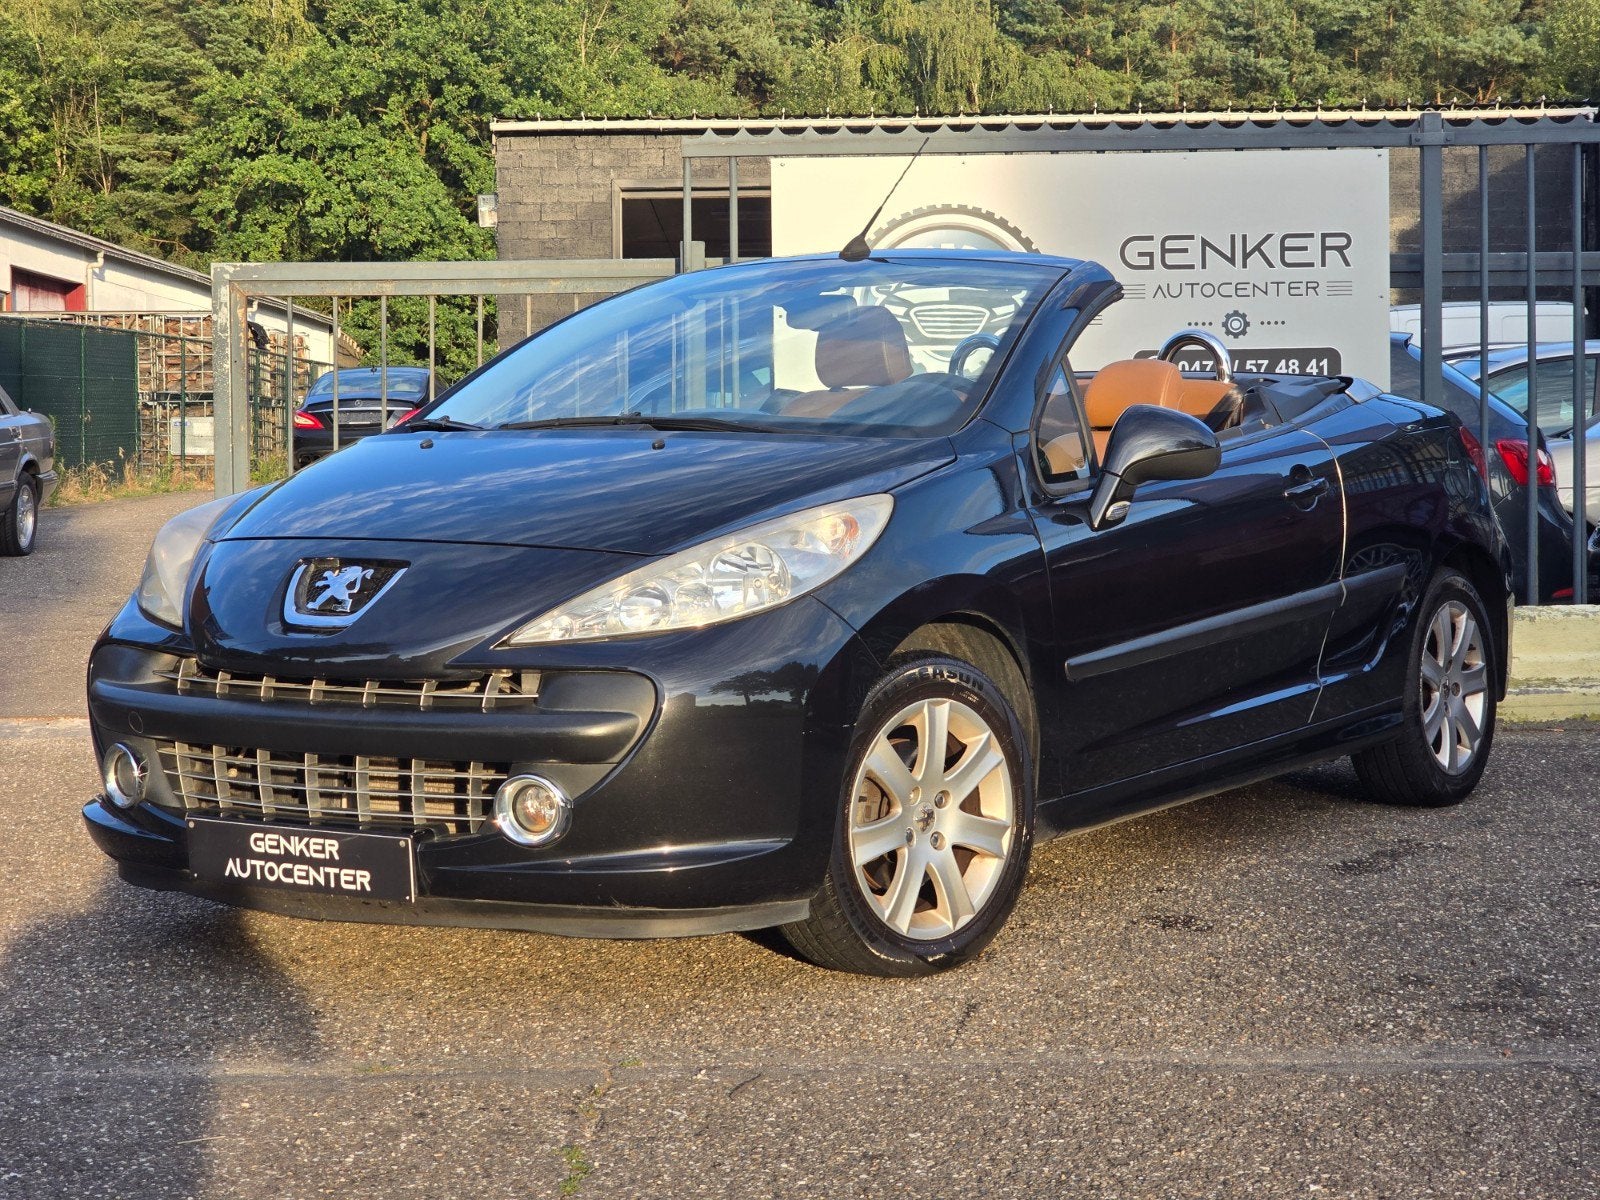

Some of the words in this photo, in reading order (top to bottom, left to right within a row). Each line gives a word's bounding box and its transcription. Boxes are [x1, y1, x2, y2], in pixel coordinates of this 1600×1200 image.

[1119, 232, 1352, 270] GENKER
[1153, 281, 1320, 298] AUTOCENTER
[1245, 360, 1269, 373] 57
[1275, 359, 1299, 375] 48
[1305, 358, 1329, 376] 41
[250, 832, 340, 860] GENKER
[225, 857, 371, 892] AUTOCENTER
